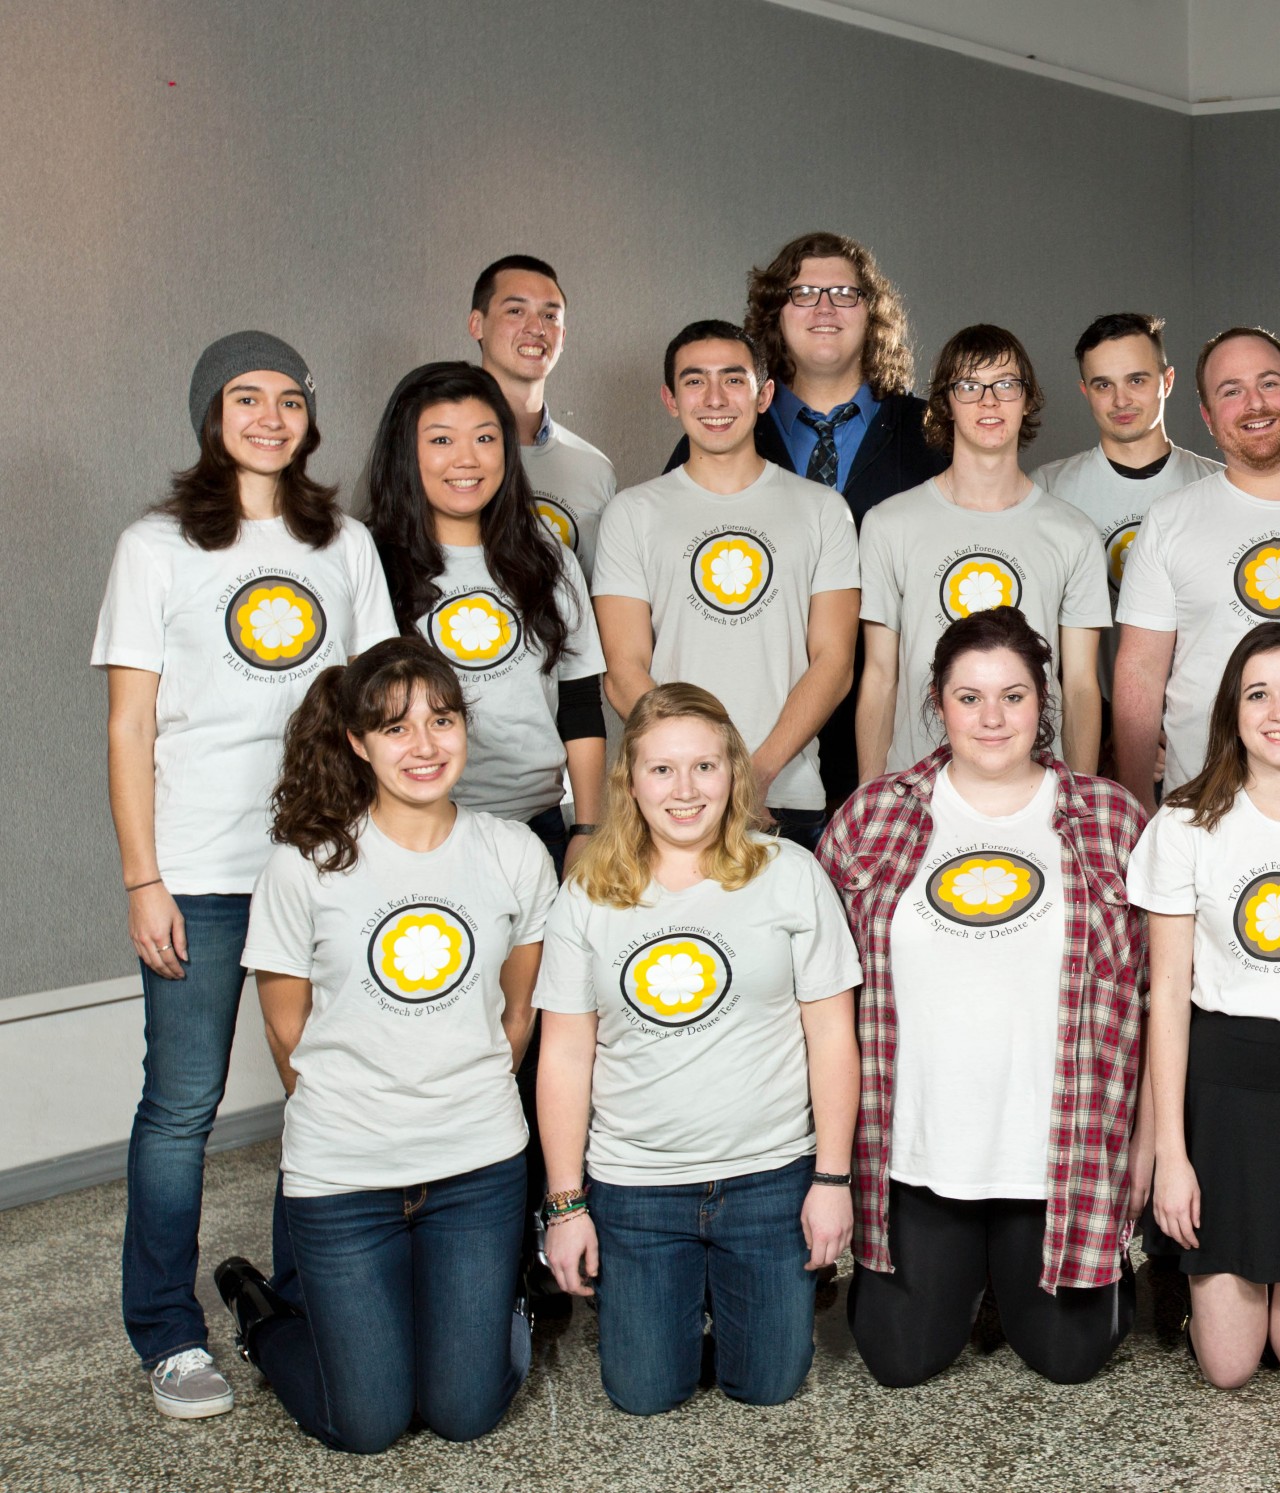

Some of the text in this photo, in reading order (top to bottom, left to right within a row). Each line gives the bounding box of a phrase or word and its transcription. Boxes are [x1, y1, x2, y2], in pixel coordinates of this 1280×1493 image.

[560, 498, 579, 520] Forum
[1114, 516, 1129, 527] Karl
[702, 527, 720, 537] Karl
[722, 524, 757, 534] Forensics
[759, 531, 776, 554] Forum
[1249, 533, 1267, 544] Karl
[954, 546, 971, 557] Karl
[974, 544, 1009, 559] Forensics
[1010, 557, 1026, 580] Forum
[236, 569, 256, 584] Karl
[258, 566, 299, 579] Forensics
[302, 576, 324, 602] Forum
[687, 594, 702, 611] PLU
[701, 609, 726, 625] Speech
[740, 608, 763, 624] Debate
[761, 588, 779, 607] Team
[1229, 600, 1246, 618] PLU
[223, 641, 334, 683] PLU Speech & Debate Team
[483, 666, 513, 682] Debate
[956, 844, 977, 854] Karl
[981, 843, 1025, 855] Forensics
[1026, 852, 1048, 871] Forum
[1250, 863, 1268, 876] Karl
[387, 896, 409, 910] Karl
[412, 893, 455, 908] Forensics
[456, 905, 479, 932] Forum
[913, 900, 1053, 939] PLU Speech & Debate Team
[642, 928, 665, 941] Karl
[668, 925, 712, 936] Forensics
[713, 932, 736, 959] Forum
[1228, 940, 1244, 960] PLU
[1242, 958, 1269, 973] Speech
[361, 972, 480, 1016] PLU Speech & Debate Team
[621, 994, 741, 1038] PLU Speech & Debate Team
